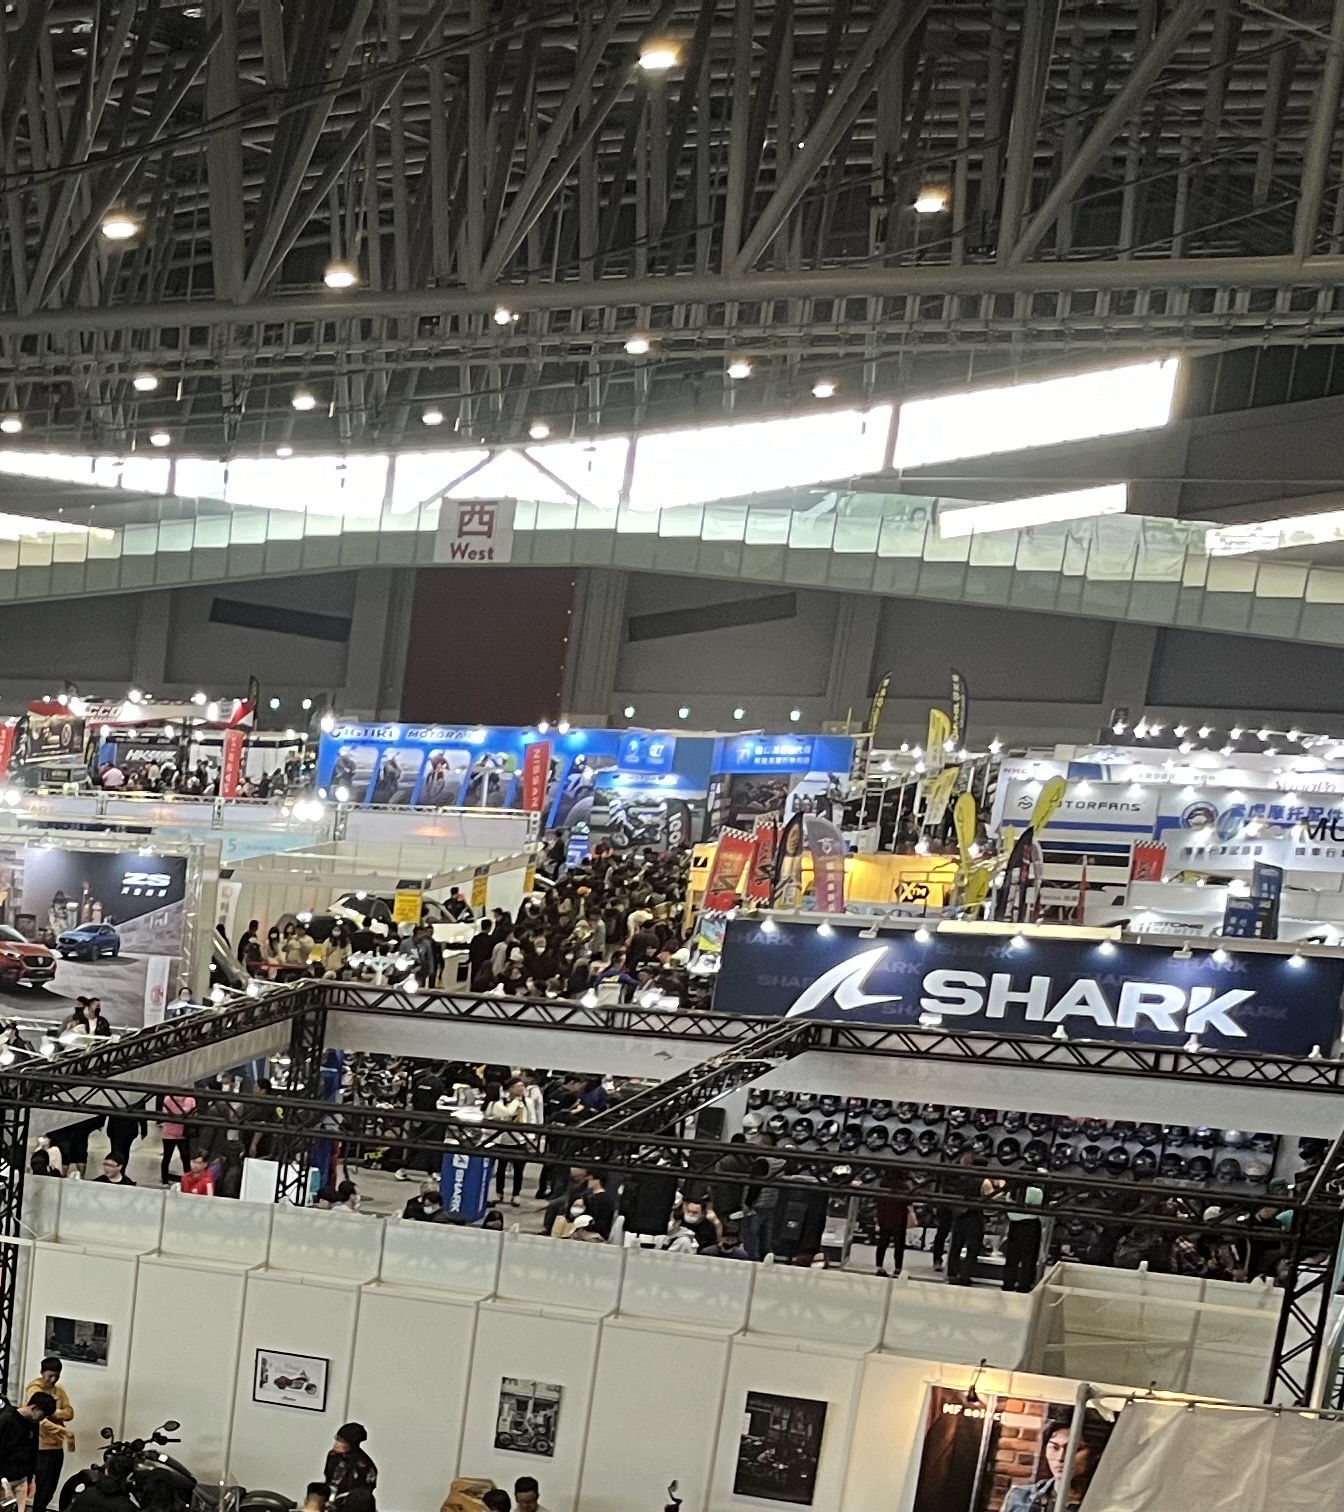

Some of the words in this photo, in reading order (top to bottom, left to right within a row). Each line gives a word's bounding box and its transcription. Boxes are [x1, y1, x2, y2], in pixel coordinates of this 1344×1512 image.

[457, 501, 496, 540] 西
[449, 542, 495, 562] West
[1052, 800, 1142, 813] OTORFANS
[919, 968, 1257, 1038] SHARK
